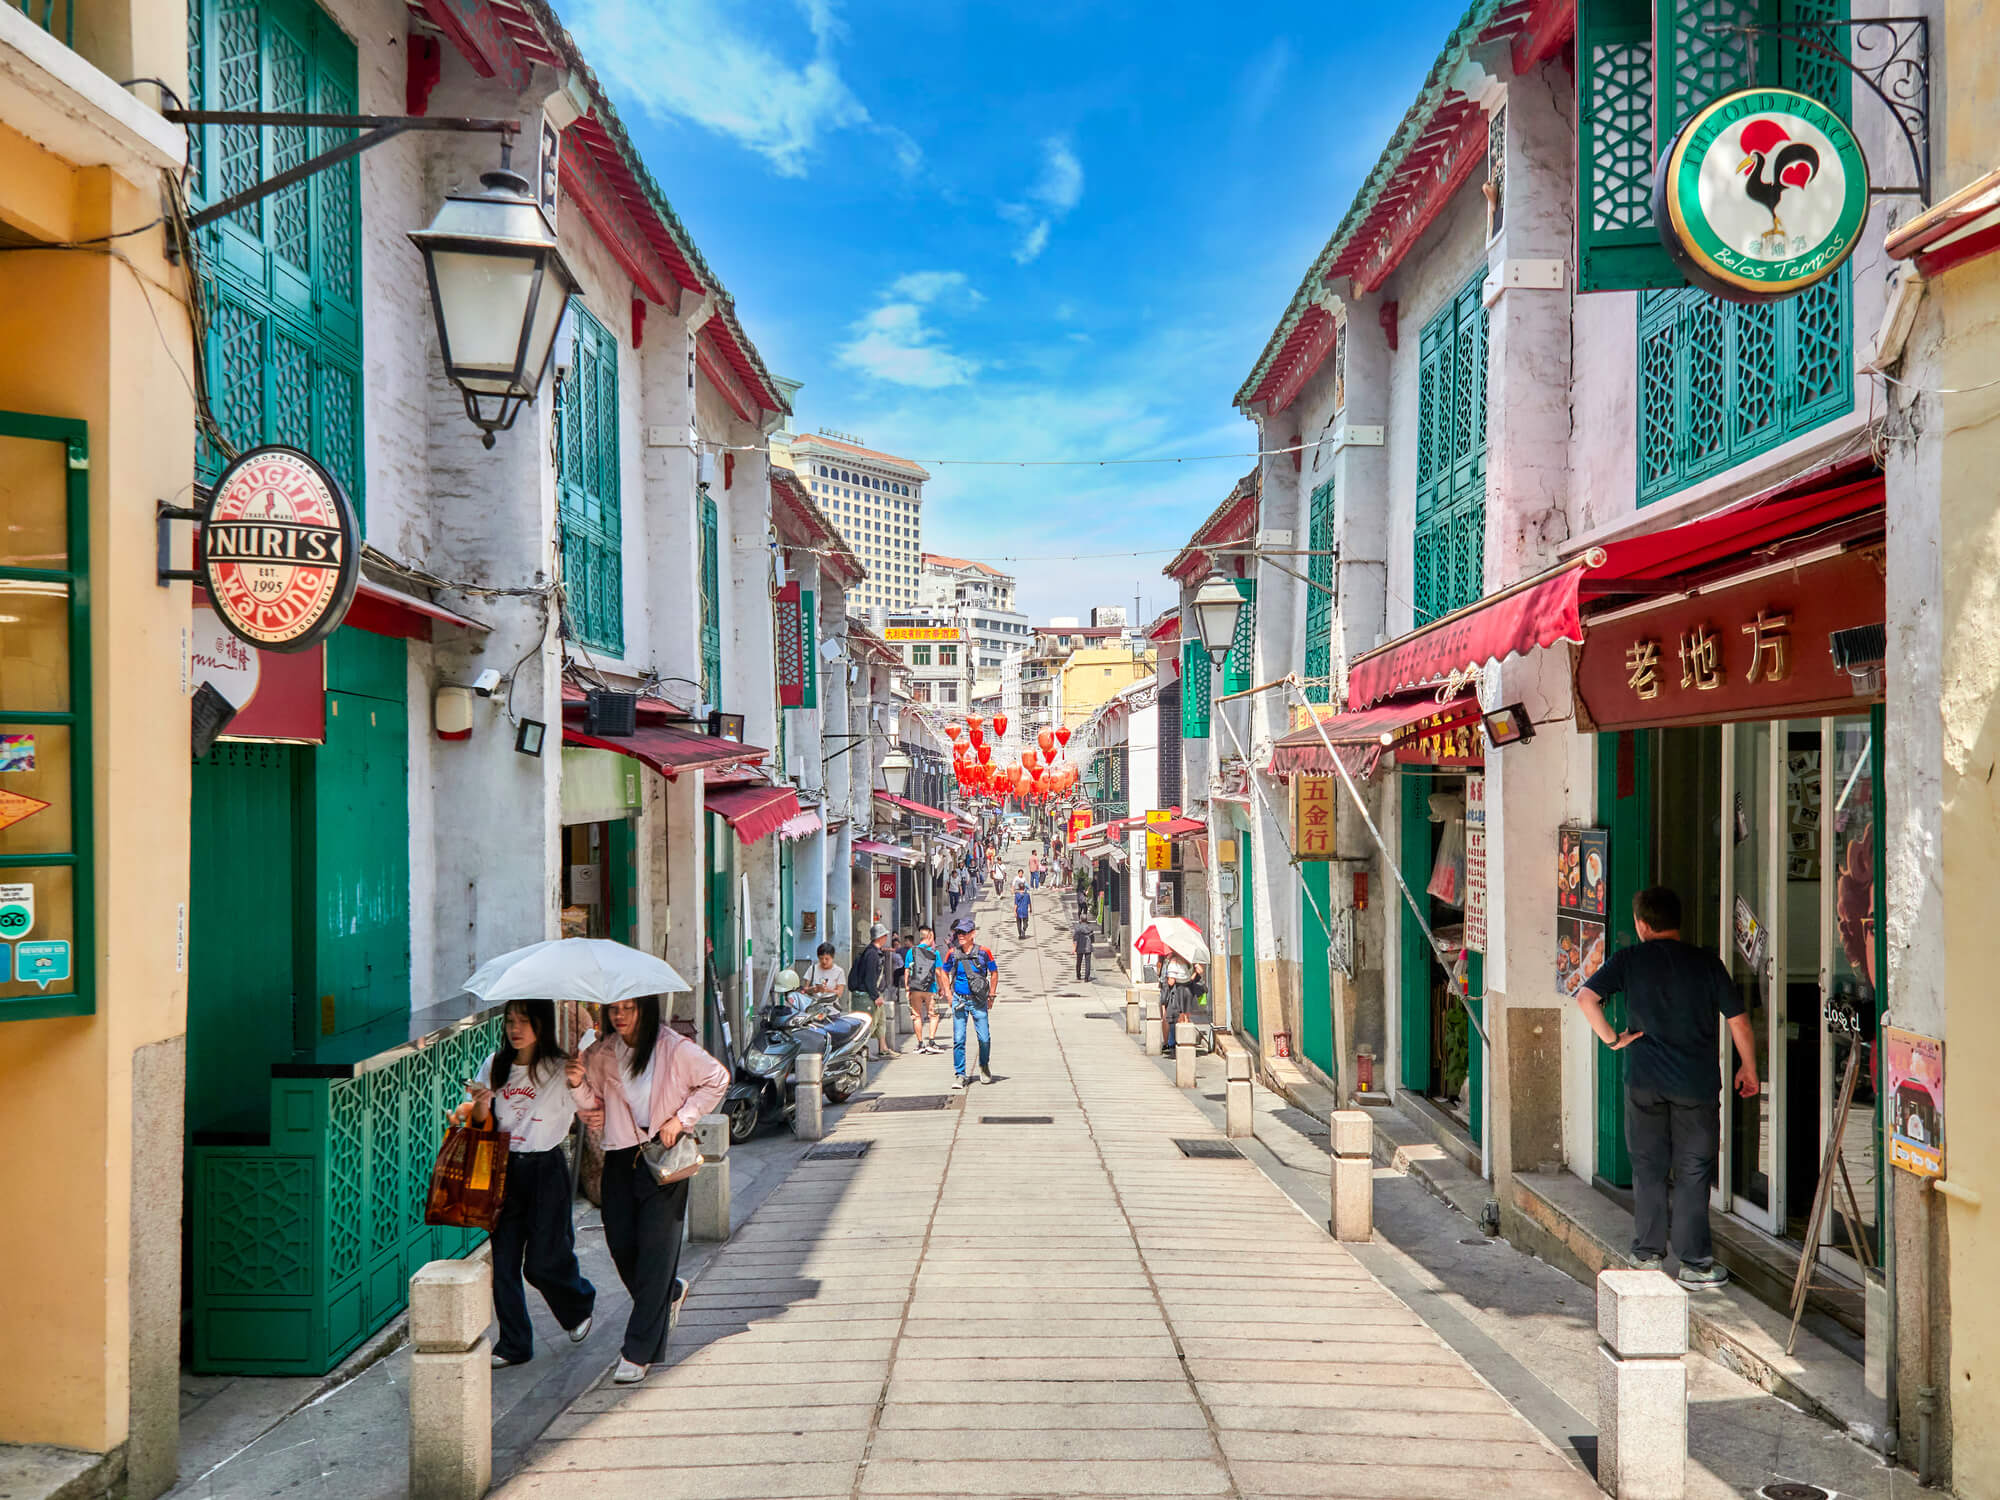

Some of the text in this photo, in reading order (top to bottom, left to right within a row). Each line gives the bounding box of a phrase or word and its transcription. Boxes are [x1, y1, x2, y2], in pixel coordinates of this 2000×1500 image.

[1683, 95, 1855, 169] THE OLD PLACE
[1713, 247, 1767, 279] Belos
[1774, 233, 1844, 279] Tempos
[217, 527, 327, 560] NURI'S
[253, 580, 283, 594] 1995
[1625, 609, 1788, 700] 老地方
[1302, 780, 1329, 850] 五金行
